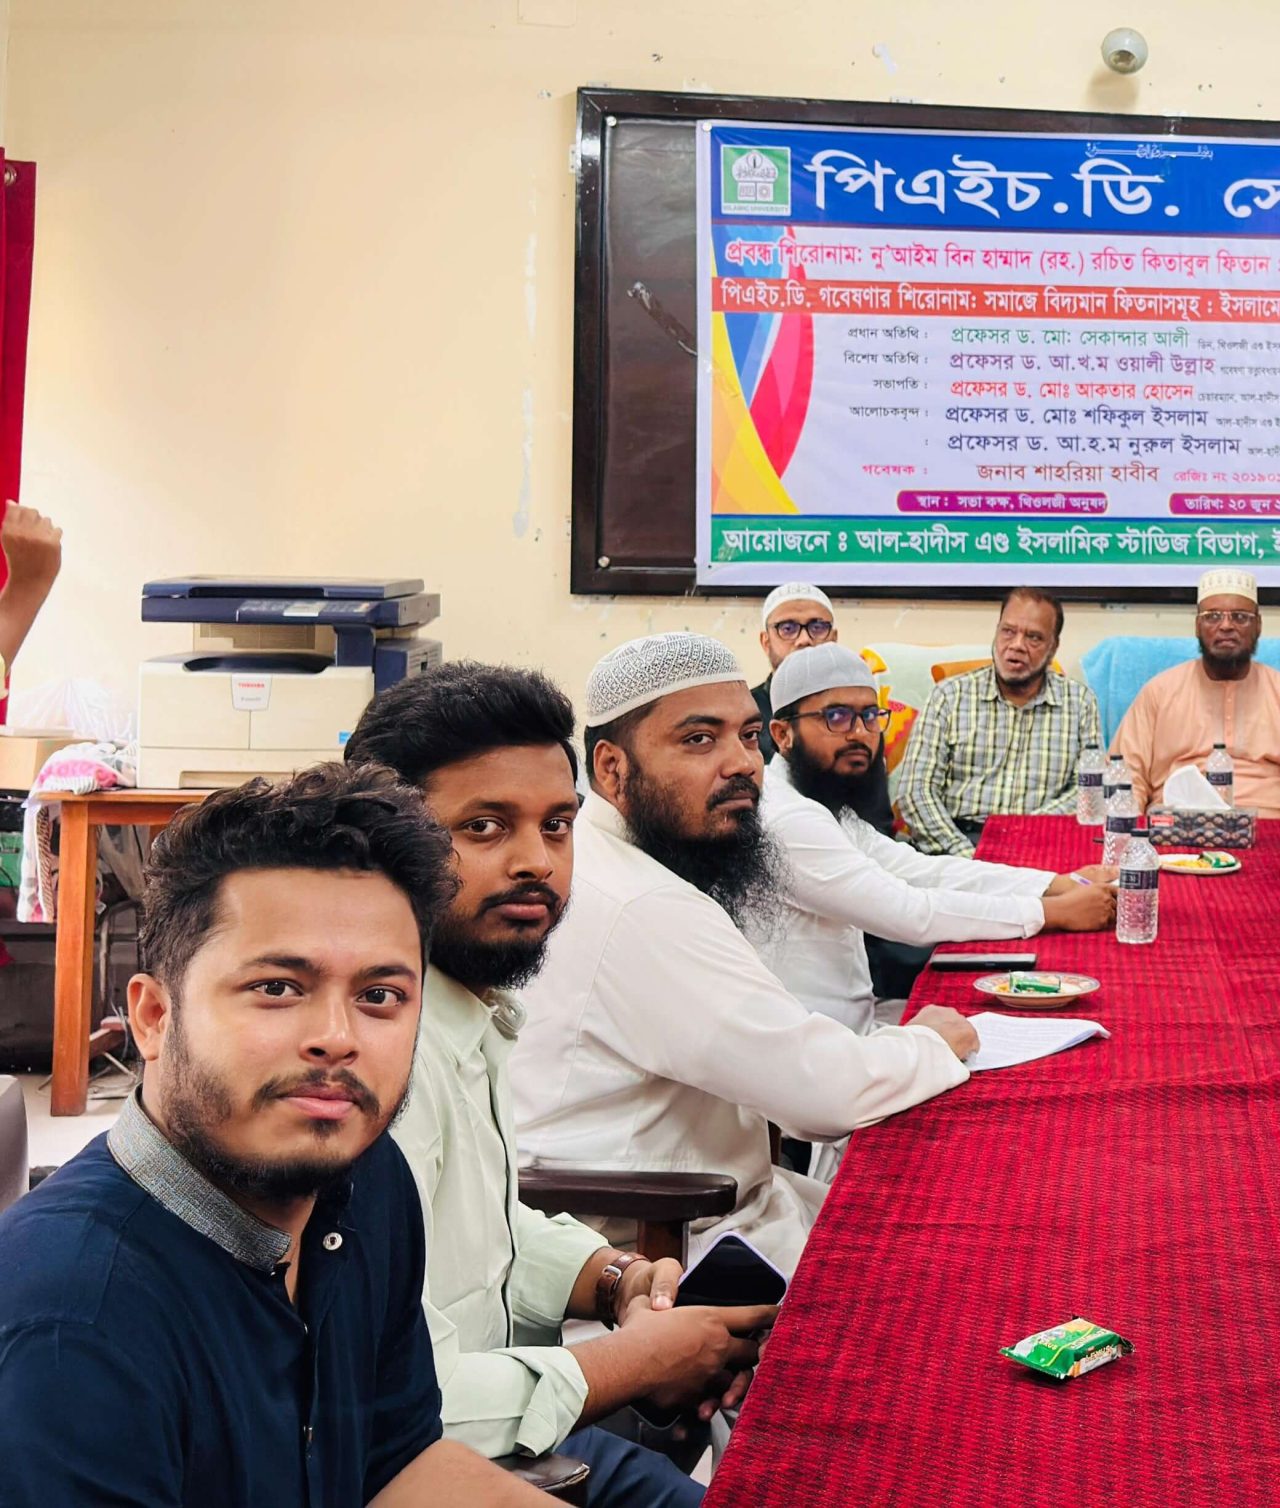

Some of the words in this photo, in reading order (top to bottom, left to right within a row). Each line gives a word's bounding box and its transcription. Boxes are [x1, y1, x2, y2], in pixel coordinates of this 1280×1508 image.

[804, 148, 1181, 219] পিএইচ.ডি.
[726, 239, 777, 265] প্রবন্ধ
[945, 243, 975, 268] বিন
[981, 248, 1032, 269] হাম্মাদ
[1040, 250, 1084, 275] (রহ.)
[1091, 247, 1136, 271] রচিত
[1142, 247, 1209, 278] কিতাবুল
[1216, 250, 1271, 274] ফিতান
[819, 285, 891, 308] গবেষণার
[983, 289, 1038, 312] সমাজে
[1043, 286, 1108, 314] বিদ্যমান
[1113, 288, 1201, 321] ফিতনাসমূহ
[847, 327, 878, 339] প্রধান
[882, 326, 919, 339] অতিথি
[951, 328, 1010, 345] প্রফেসর
[1016, 330, 1035, 345] ড.
[1080, 330, 1148, 347] সেকান্দার
[1152, 327, 1189, 348] আলী
[844, 350, 878, 364] বিশেষ
[882, 351, 919, 364] অতিথি
[950, 352, 1015, 371] প্রফেসর
[1020, 354, 1041, 371] ড.
[1048, 353, 1109, 372] আ.খ.ম
[1117, 351, 1165, 374] ওয়ালী
[1170, 354, 1216, 376] উল্লাহ
[873, 377, 919, 390] সভাপতি
[950, 380, 1008, 398] প্রফেসর
[1013, 382, 1032, 399] ড.
[1075, 382, 1137, 400] আকতার
[1143, 384, 1194, 401] হোসেন
[849, 405, 919, 422] আলোচকবৃন্দ
[945, 405, 1009, 424] প্রফেসর
[1014, 408, 1035, 425] ড.
[1082, 404, 1146, 430] শফিকুল
[1151, 406, 1209, 428] ইসলাম
[947, 433, 1018, 452] প্রফেসর
[1025, 436, 1048, 452] ড.
[1056, 434, 1121, 454] আ.হ.ম
[1127, 436, 1175, 457] নুরুল
[1180, 434, 1242, 456] ইসলাম
[862, 464, 916, 476] গবেষক
[976, 464, 1026, 483] জনাব
[1033, 460, 1105, 484] শাহরিয়া
[1110, 460, 1160, 483] হাবীব
[1229, 498, 1246, 511] ২০
[1250, 498, 1269, 513] জুন
[721, 527, 831, 553] আয়োজনে
[855, 524, 969, 555] আল-হাদীস
[1017, 525, 1110, 555] ইসলামিক
[1116, 526, 1191, 555] স্টাডিজ
[1195, 527, 1264, 559] বিভাগ,
